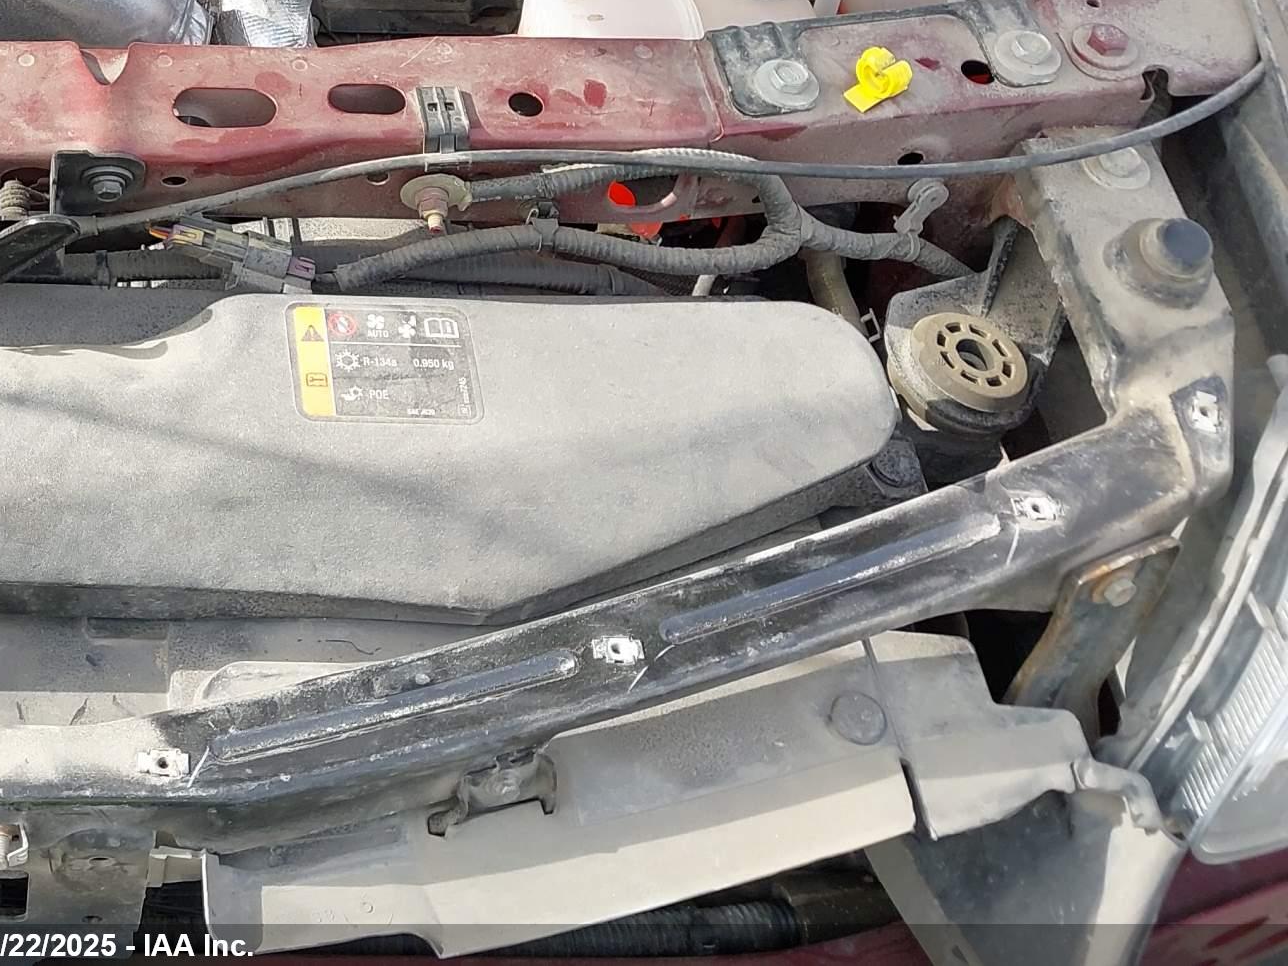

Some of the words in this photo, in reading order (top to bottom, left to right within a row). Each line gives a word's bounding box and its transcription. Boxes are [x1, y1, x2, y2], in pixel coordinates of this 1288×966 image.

[367, 329, 389, 339] AUTO
[362, 357, 398, 368] R-134a
[413, 358, 440, 369] 0.950
[441, 358, 455, 371] kg
[368, 388, 390, 401] POE
